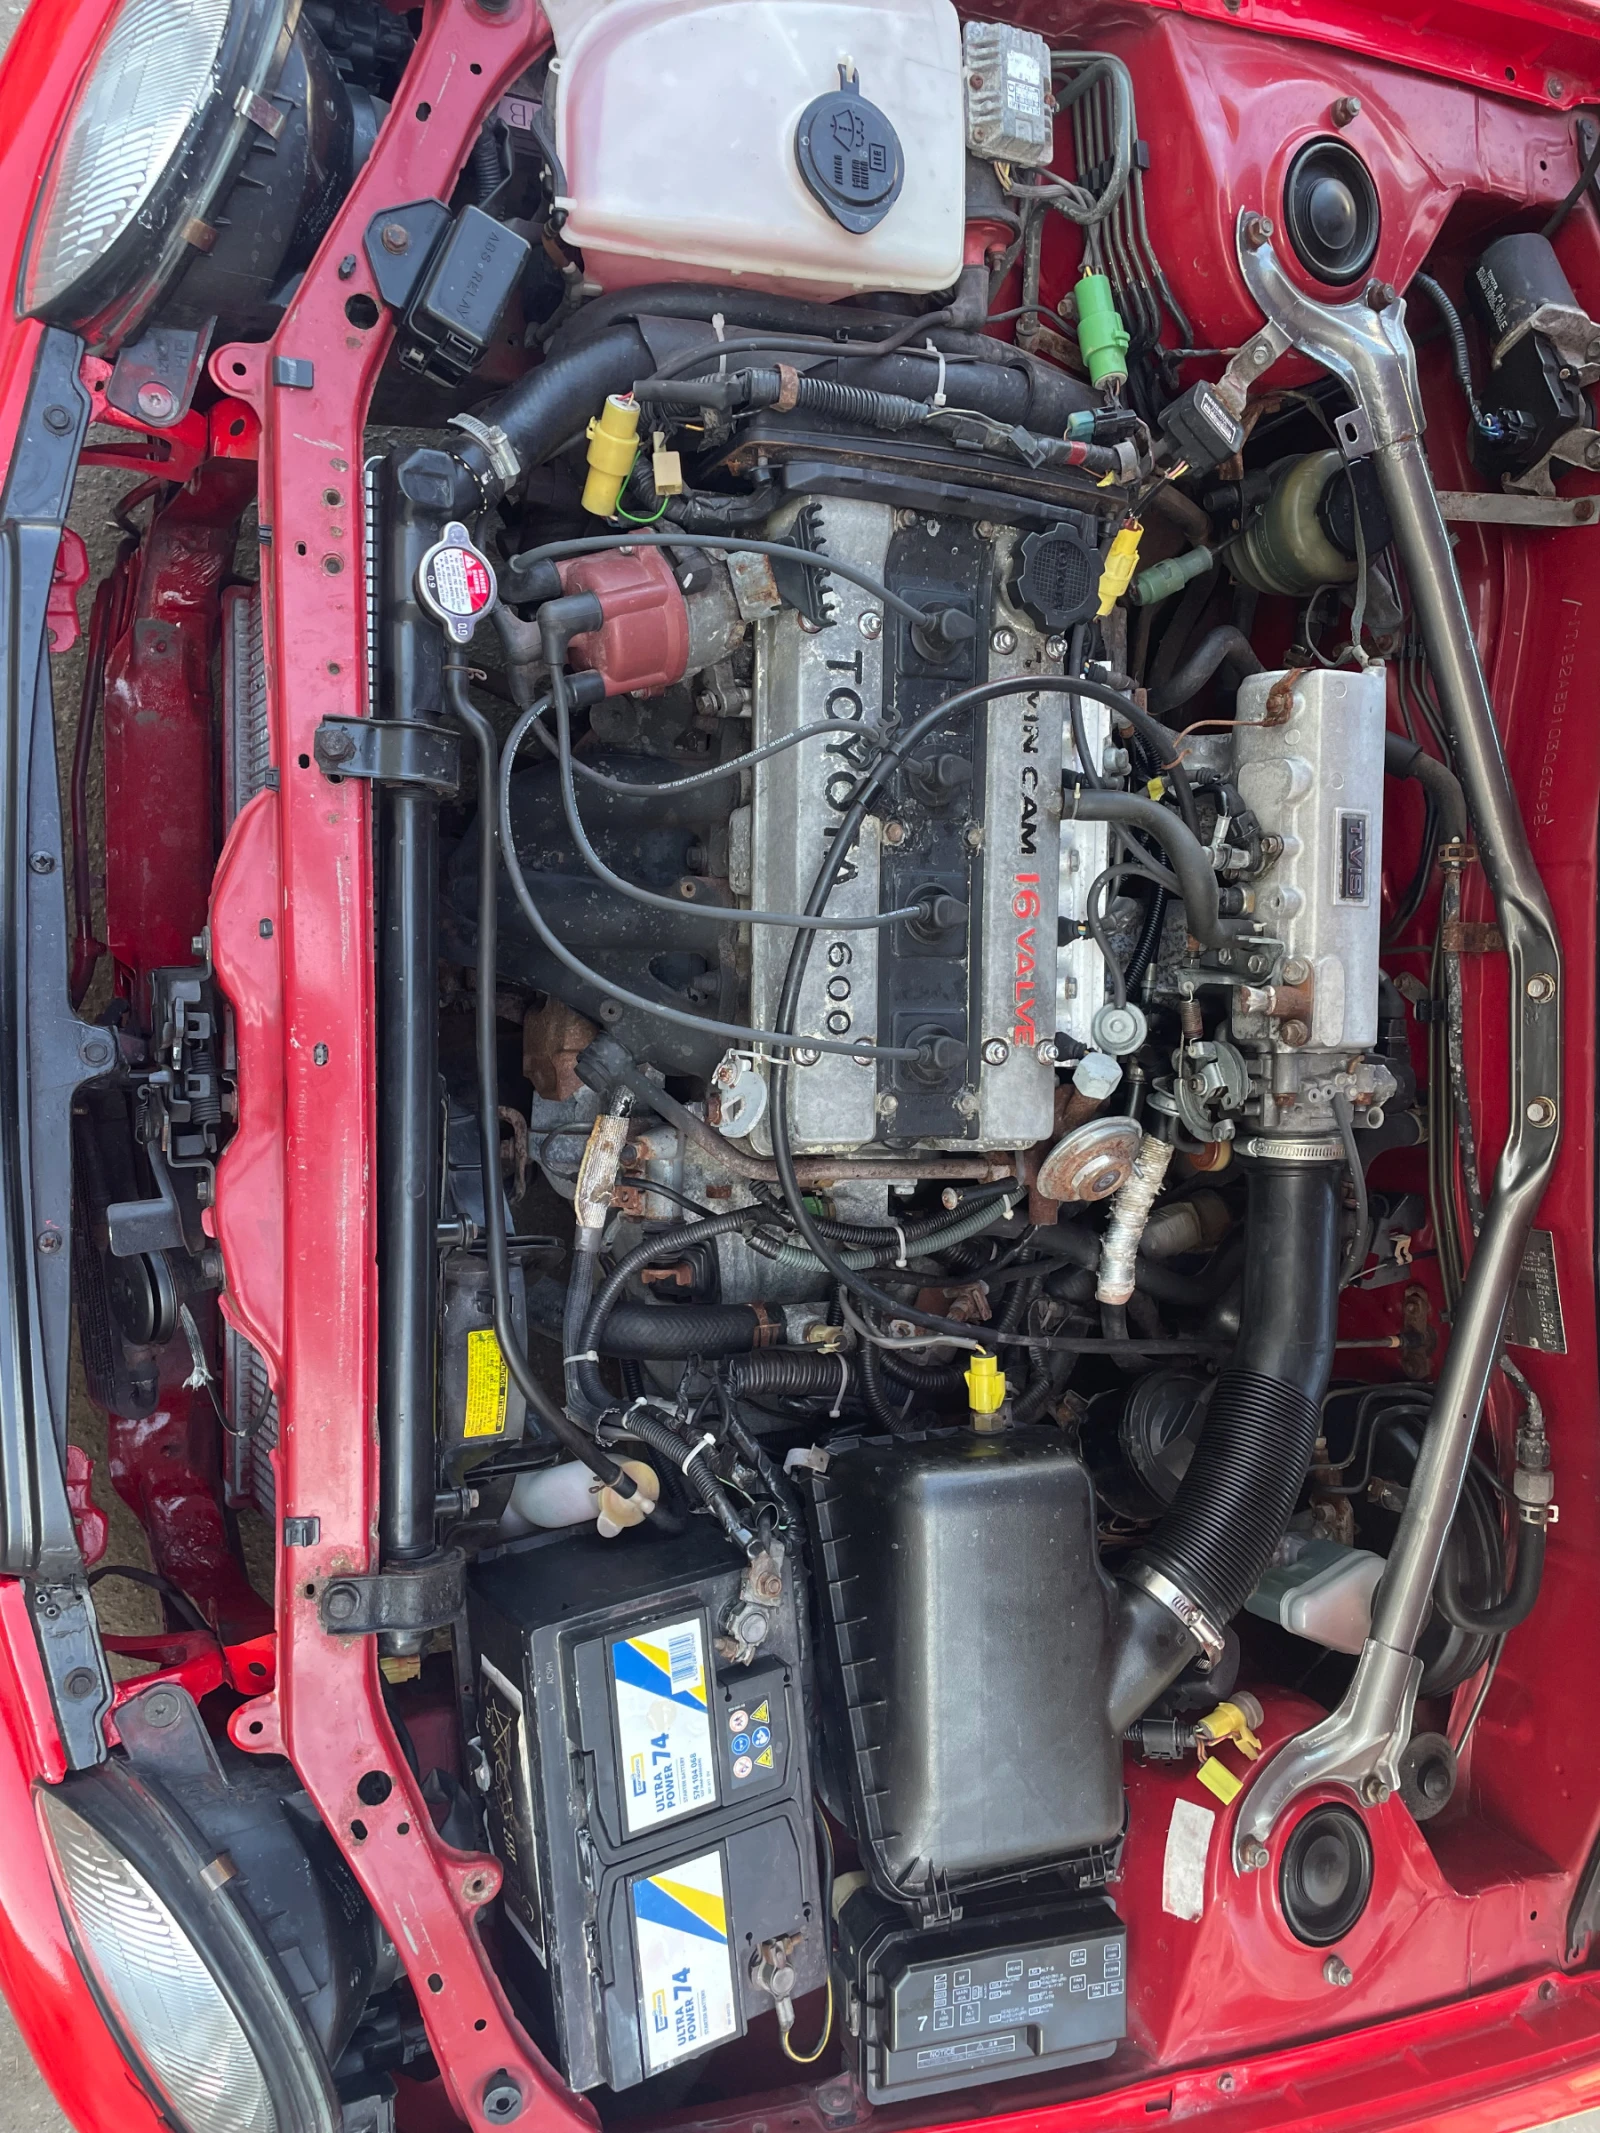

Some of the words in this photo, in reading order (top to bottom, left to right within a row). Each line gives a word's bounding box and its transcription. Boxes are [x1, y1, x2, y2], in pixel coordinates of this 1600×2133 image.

[480, 230, 500, 263] ABS
[456, 270, 484, 320] RELAY
[427, 574, 437, 589] 0.9
[478, 569, 487, 594] DANGER
[672, 768, 713, 788] TEMPERATURE
[738, 745, 767, 763] SILICONE
[1017, 768, 1039, 856] CAM
[1349, 821, 1364, 894] T-VIS
[1011, 872, 1041, 920] 16
[1013, 927, 1041, 1048] VALVE
[497, 1395, 505, 1427] ATTENTION
[651, 1732, 671, 1767] 74
[689, 1753, 698, 1768] 068
[653, 1771, 665, 1813] ULTRA
[664, 1762, 676, 1808] POWER
[691, 1769, 699, 1784] 104
[692, 1785, 701, 1800] 574
[672, 1967, 692, 2001] 74
[675, 2006, 687, 2046] ULTRA
[685, 1997, 697, 2042] POWER
[917, 2015, 928, 2031] 7
[929, 2047, 955, 2058] NOTICE
